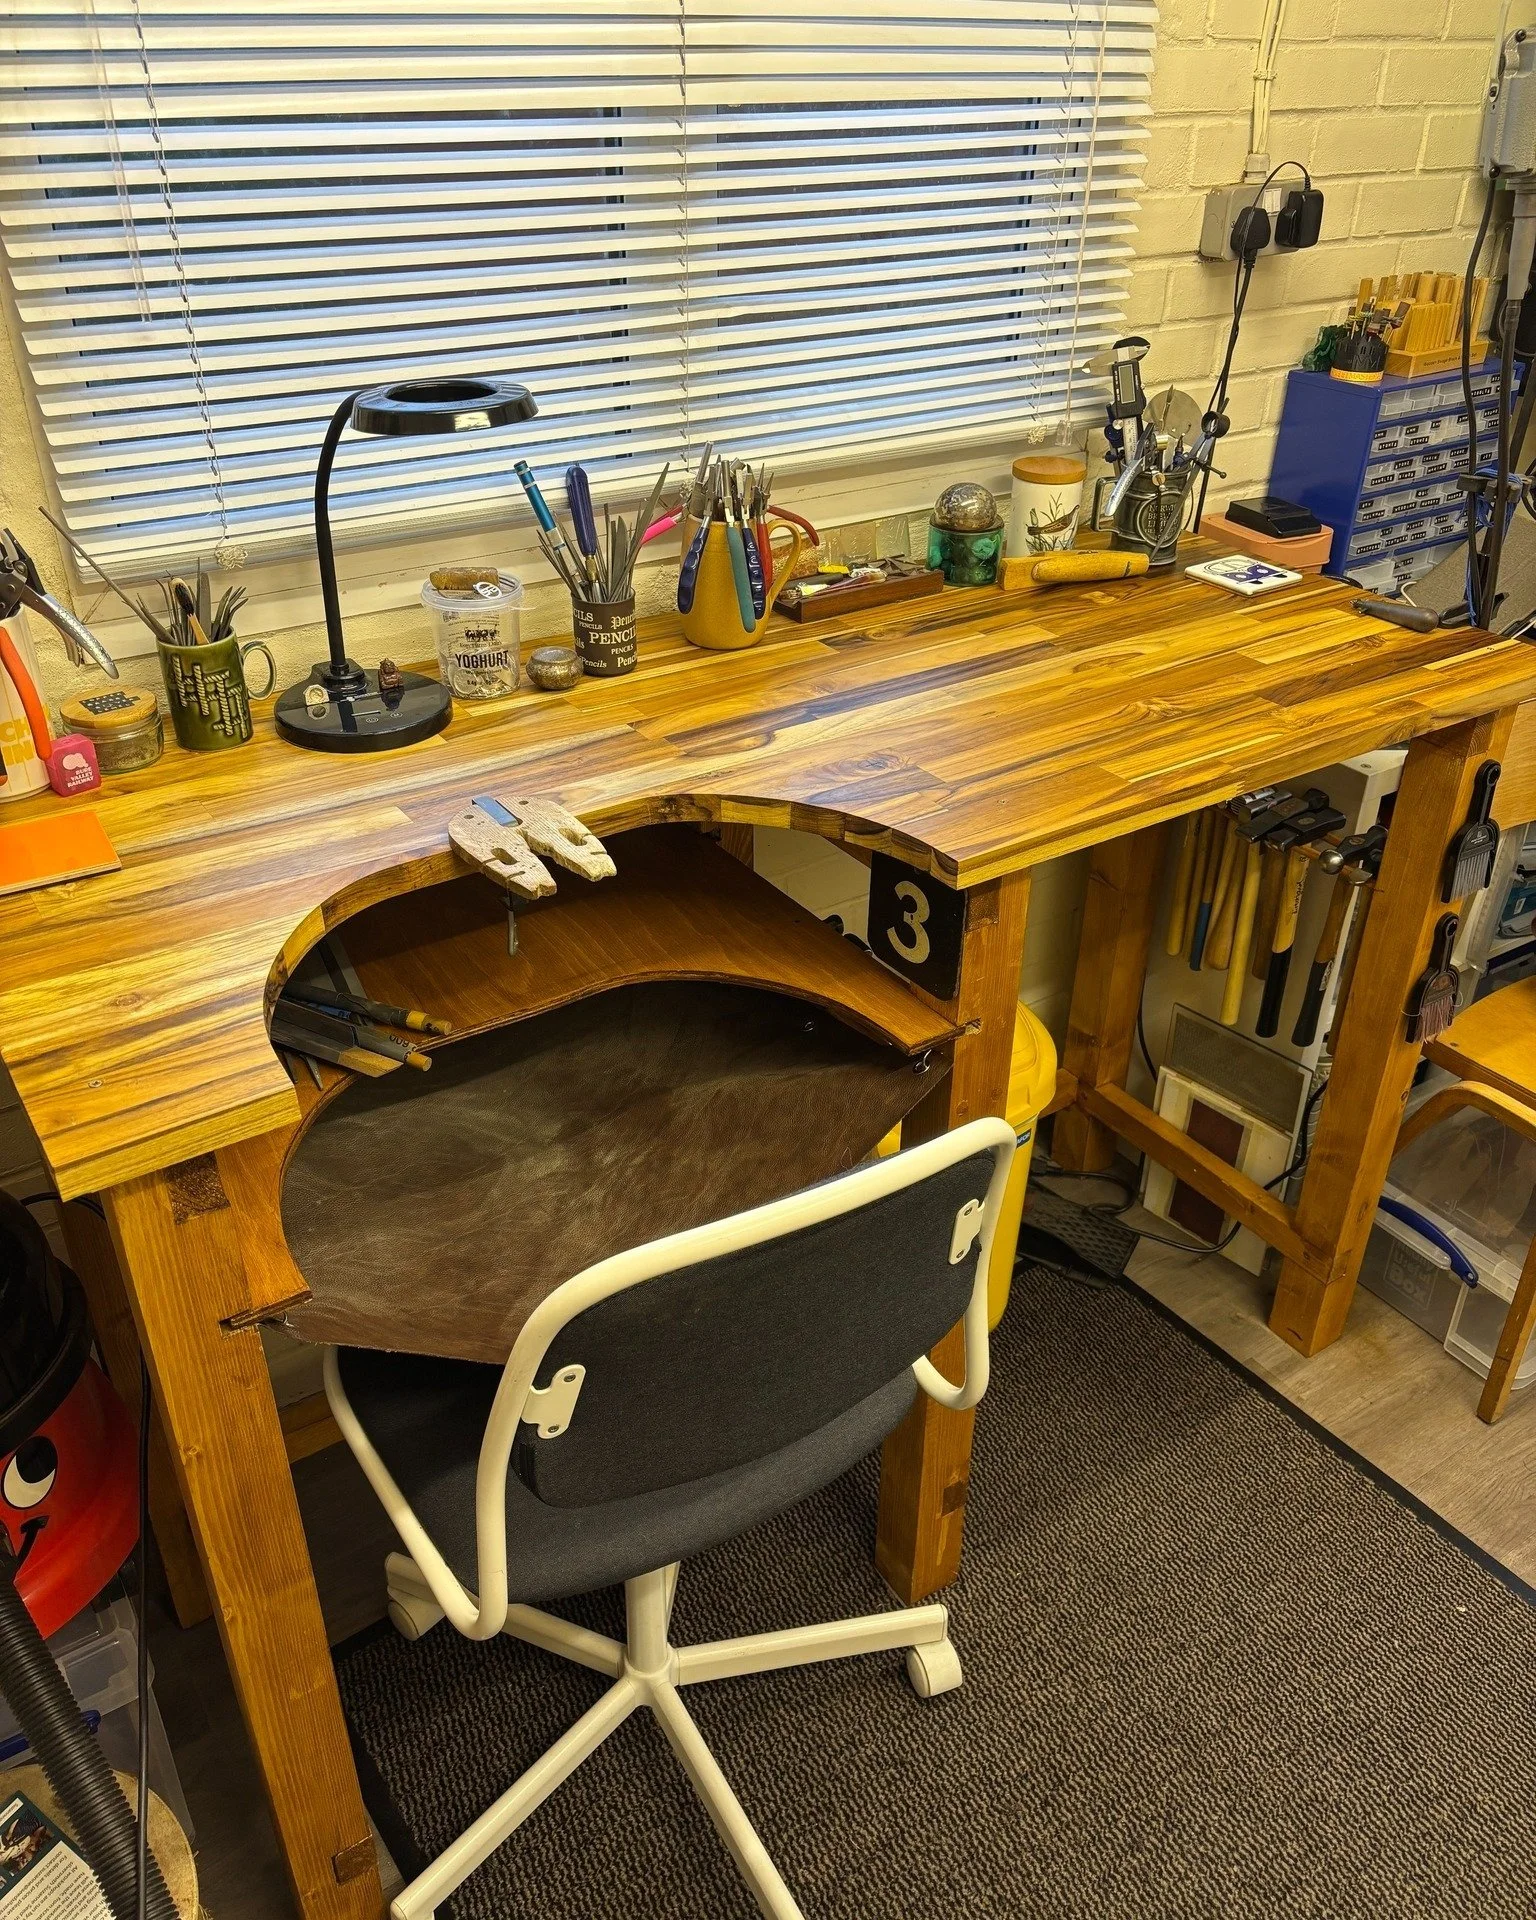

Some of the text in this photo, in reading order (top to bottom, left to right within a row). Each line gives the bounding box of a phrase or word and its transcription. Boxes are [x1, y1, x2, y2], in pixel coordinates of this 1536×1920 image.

[589, 625, 636, 644] PENCI
[611, 644, 634, 654] PENCILS
[455, 650, 508, 668] YOGHURT
[67, 776, 94, 788] RAILWAY
[70, 771, 93, 782] VALLEY
[886, 880, 930, 964] 3
[58, 1855, 68, 1864] For
[44, 1862, 60, 1879] details
[49, 1861, 74, 1886] silversmith
[0, 1850, 63, 1915] contact suzanne@seedsilvers
[35, 1877, 45, 1888] and
[47, 1871, 72, 1897] workshops
[73, 1871, 85, 1884] have
[80, 1876, 90, 1885] will
[21, 1886, 36, 1901] prices
[30, 1884, 51, 1906] Suzanne
[59, 1882, 74, 1898] made,
[68, 1884, 82, 1897] leave
[40, 1895, 48, 1904] are
[48, 1896, 61, 1909] from
[54, 1880, 94, 1920] these private lesso
[61, 1896, 70, 1905] the
[61, 1884, 99, 1920] tools and traditio
[6, 1899, 23, 1916] please
[19, 1903, 33, 1917] Seed
[31, 1903, 41, 1912] run
[79, 1904, 88, 1913] the
[24, 1910, 33, 1919] by
